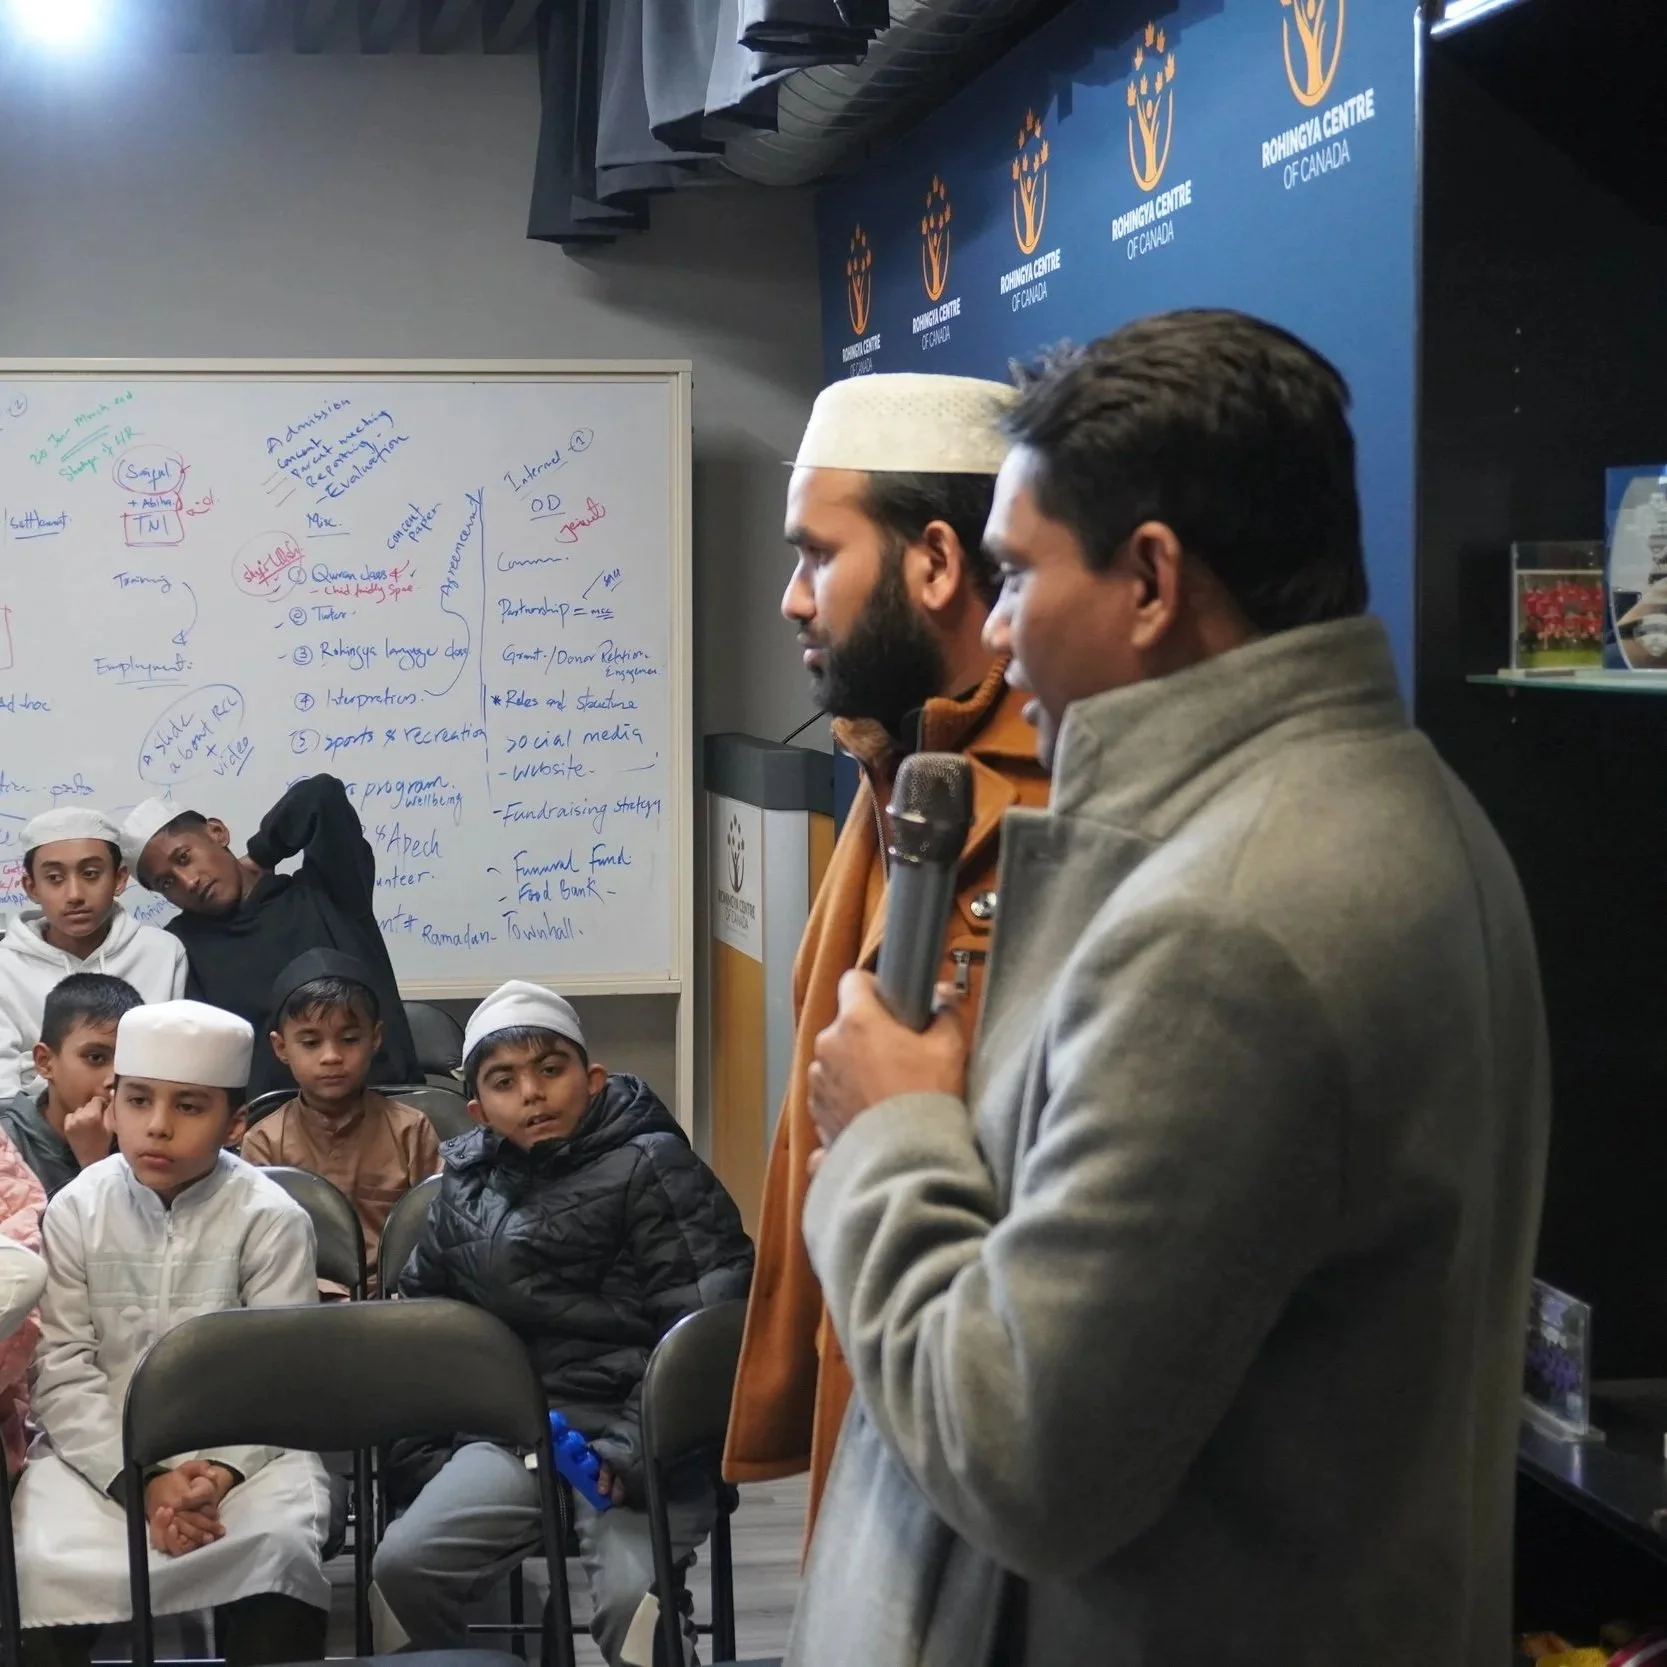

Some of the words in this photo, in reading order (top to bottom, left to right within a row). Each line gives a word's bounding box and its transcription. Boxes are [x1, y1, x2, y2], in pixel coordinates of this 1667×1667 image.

[1262, 116, 1322, 168] ROHINGYA
[1322, 88, 1375, 138] CENTRE
[1283, 159, 1299, 190] OF
[1300, 138, 1351, 183] CANADA
[1112, 200, 1155, 241] ROHINGYA
[1155, 180, 1191, 217] CENTRE
[1127, 237, 1139, 260] OF
[1139, 220, 1174, 254] CANADA
[1000, 265, 1034, 295] ROHINGYA
[1034, 249, 1061, 279] CENTRE
[912, 308, 939, 334] ROHINGYA
[939, 297, 961, 322] CENTRE
[1012, 294, 1021, 312] OF
[1021, 281, 1048, 310] CANADA
[921, 333, 929, 350] OF
[929, 325, 950, 348] CANADA
